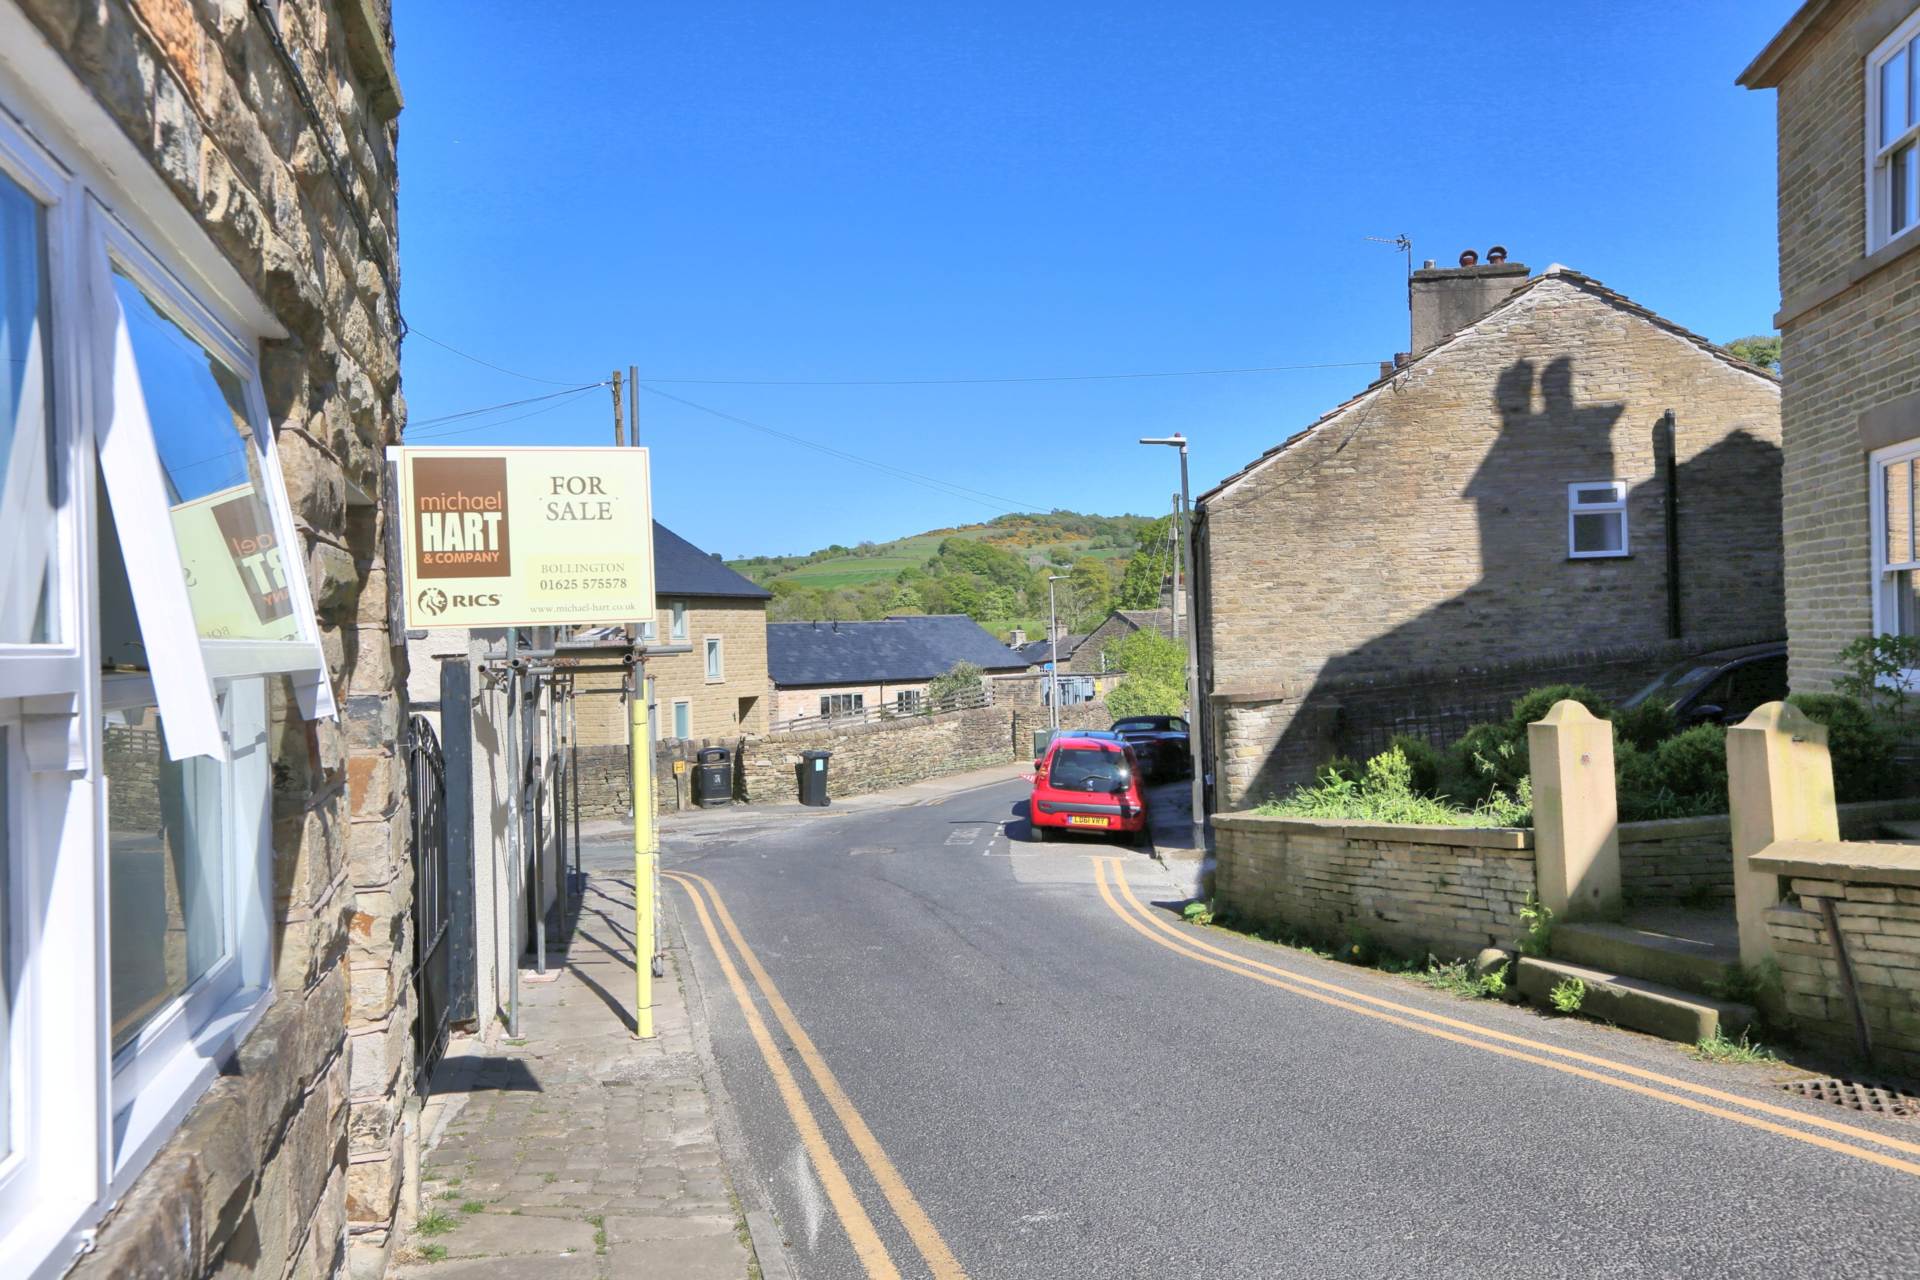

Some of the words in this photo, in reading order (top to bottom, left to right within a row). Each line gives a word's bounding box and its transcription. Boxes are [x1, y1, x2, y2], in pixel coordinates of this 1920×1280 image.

[550, 476, 607, 495] FOR
[420, 491, 502, 510] michael
[546, 501, 613, 521] SALE
[421, 512, 502, 552] HART
[423, 553, 433, 564] &
[435, 552, 500, 564] COMPANY
[541, 563, 625, 574] BOLLINGTON
[540, 579, 578, 590] 01625
[582, 578, 627, 589] 575578
[452, 594, 501, 607] RICS
[529, 602, 635, 613] www.michael-hart.co.uk
